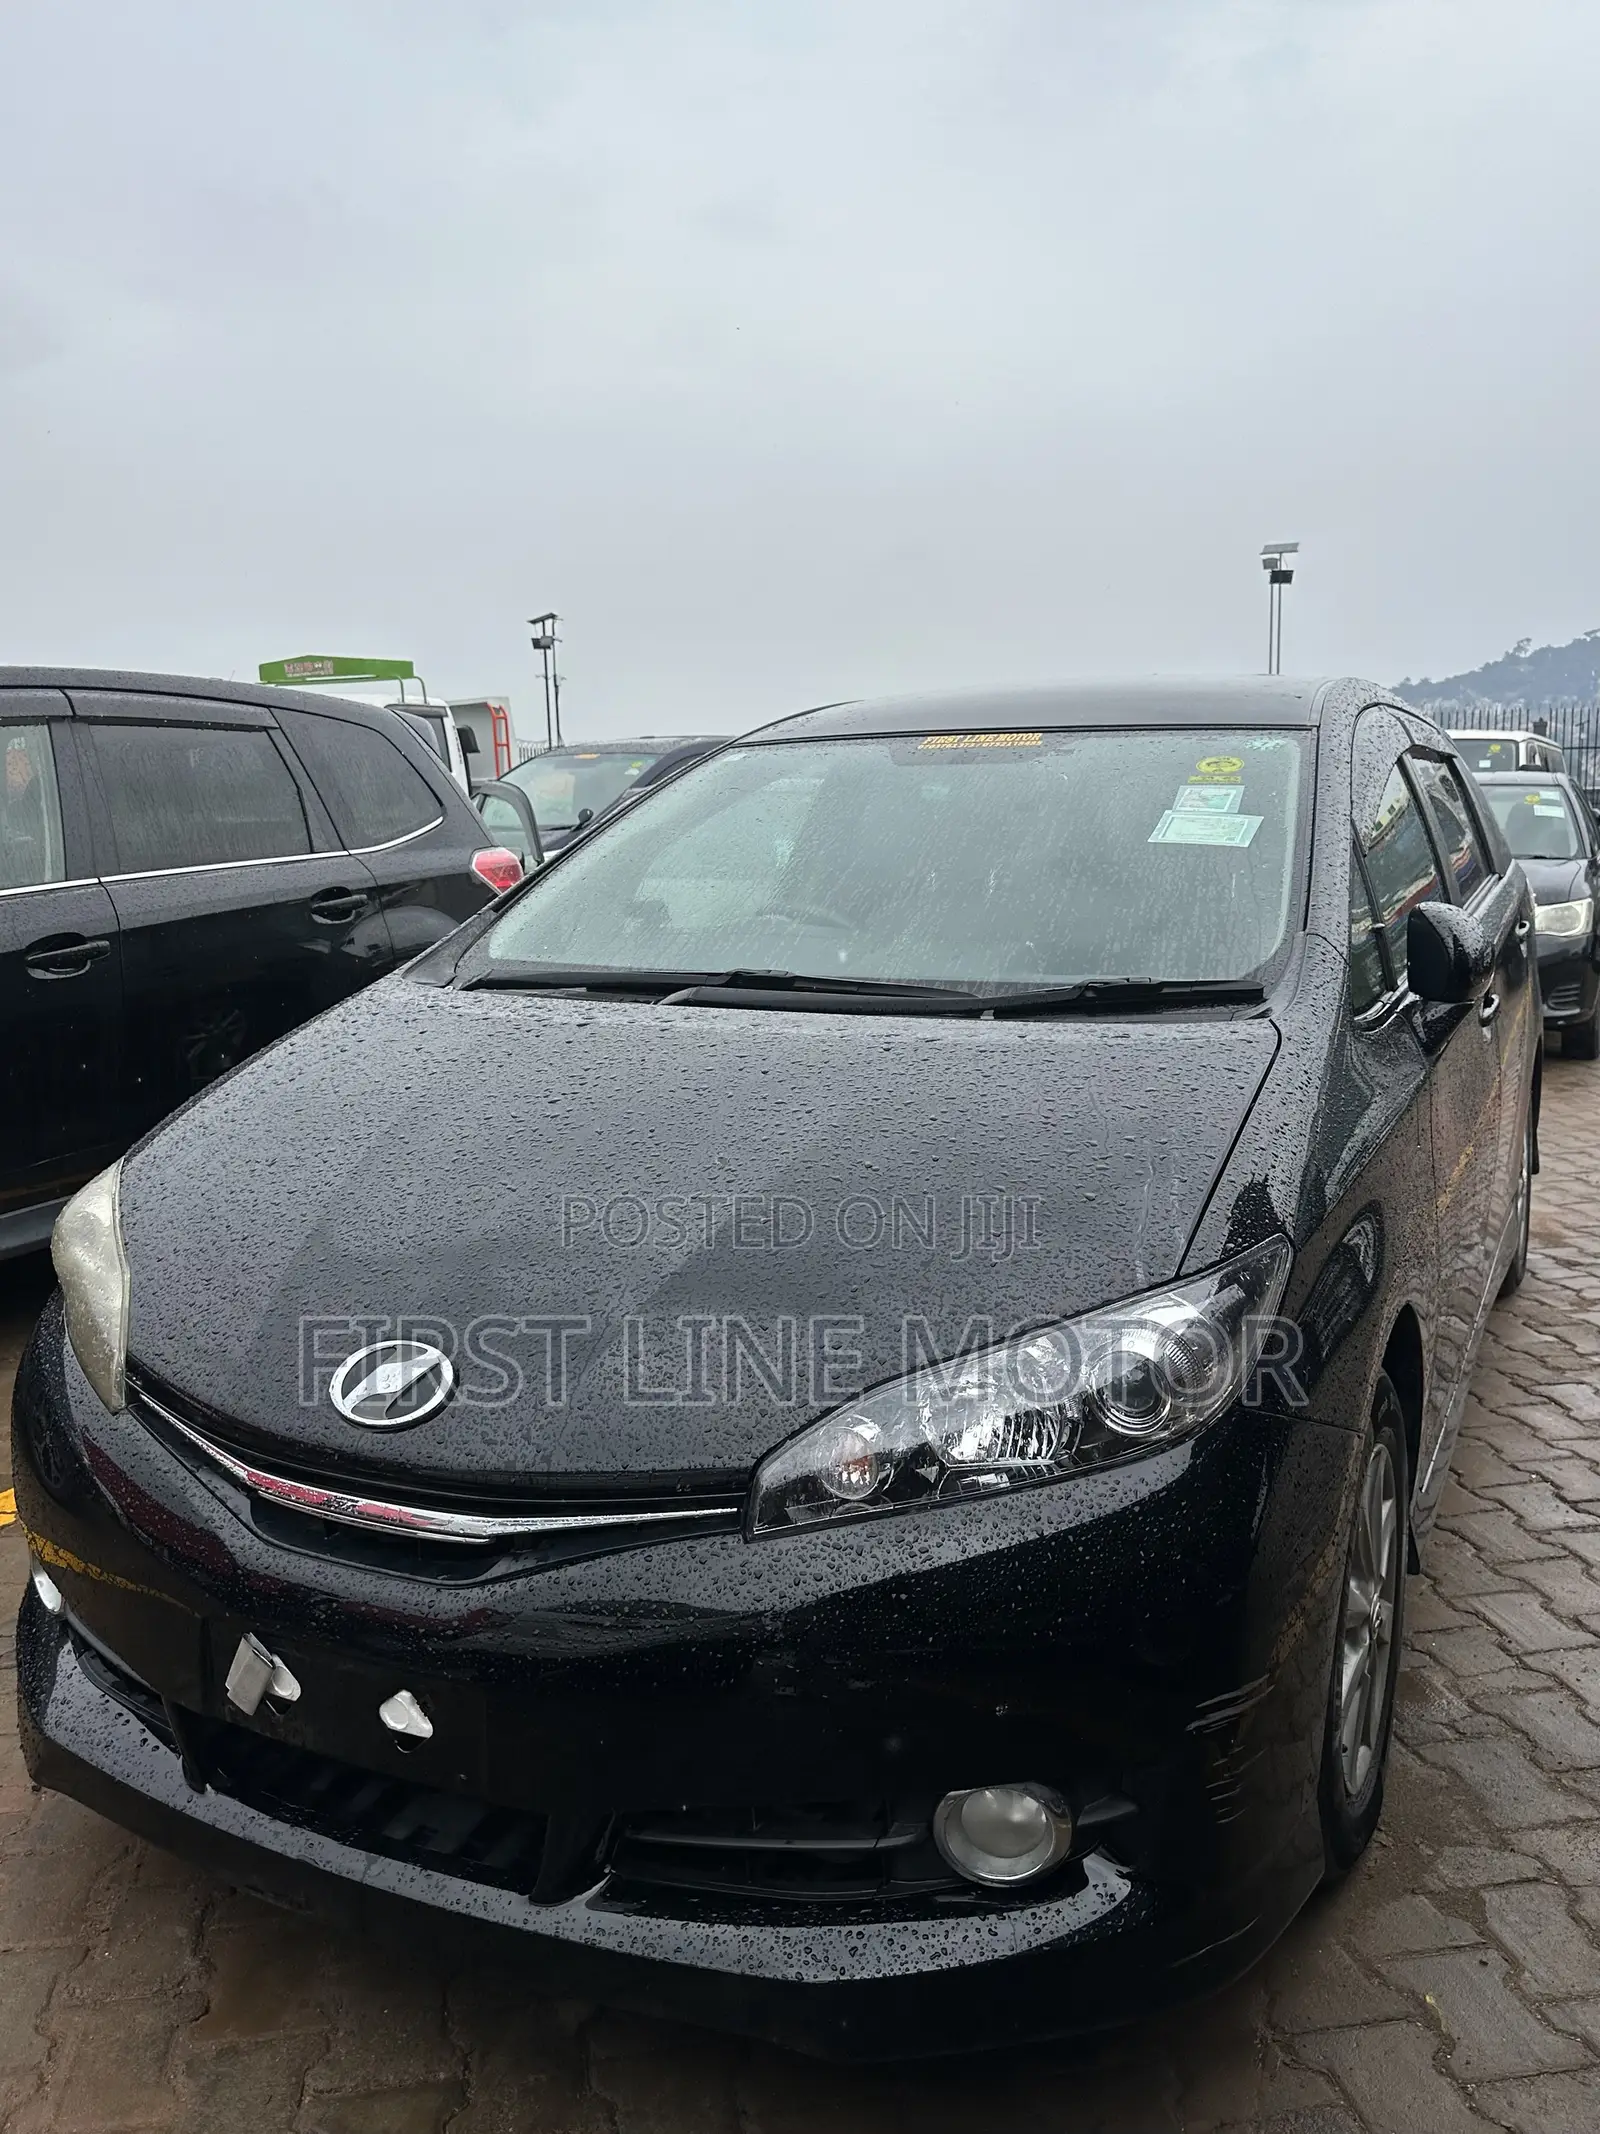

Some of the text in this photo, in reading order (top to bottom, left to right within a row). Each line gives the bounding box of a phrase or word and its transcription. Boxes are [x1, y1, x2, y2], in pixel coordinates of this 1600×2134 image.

[922, 732, 1043, 744] FIRST LINE MOTOR
